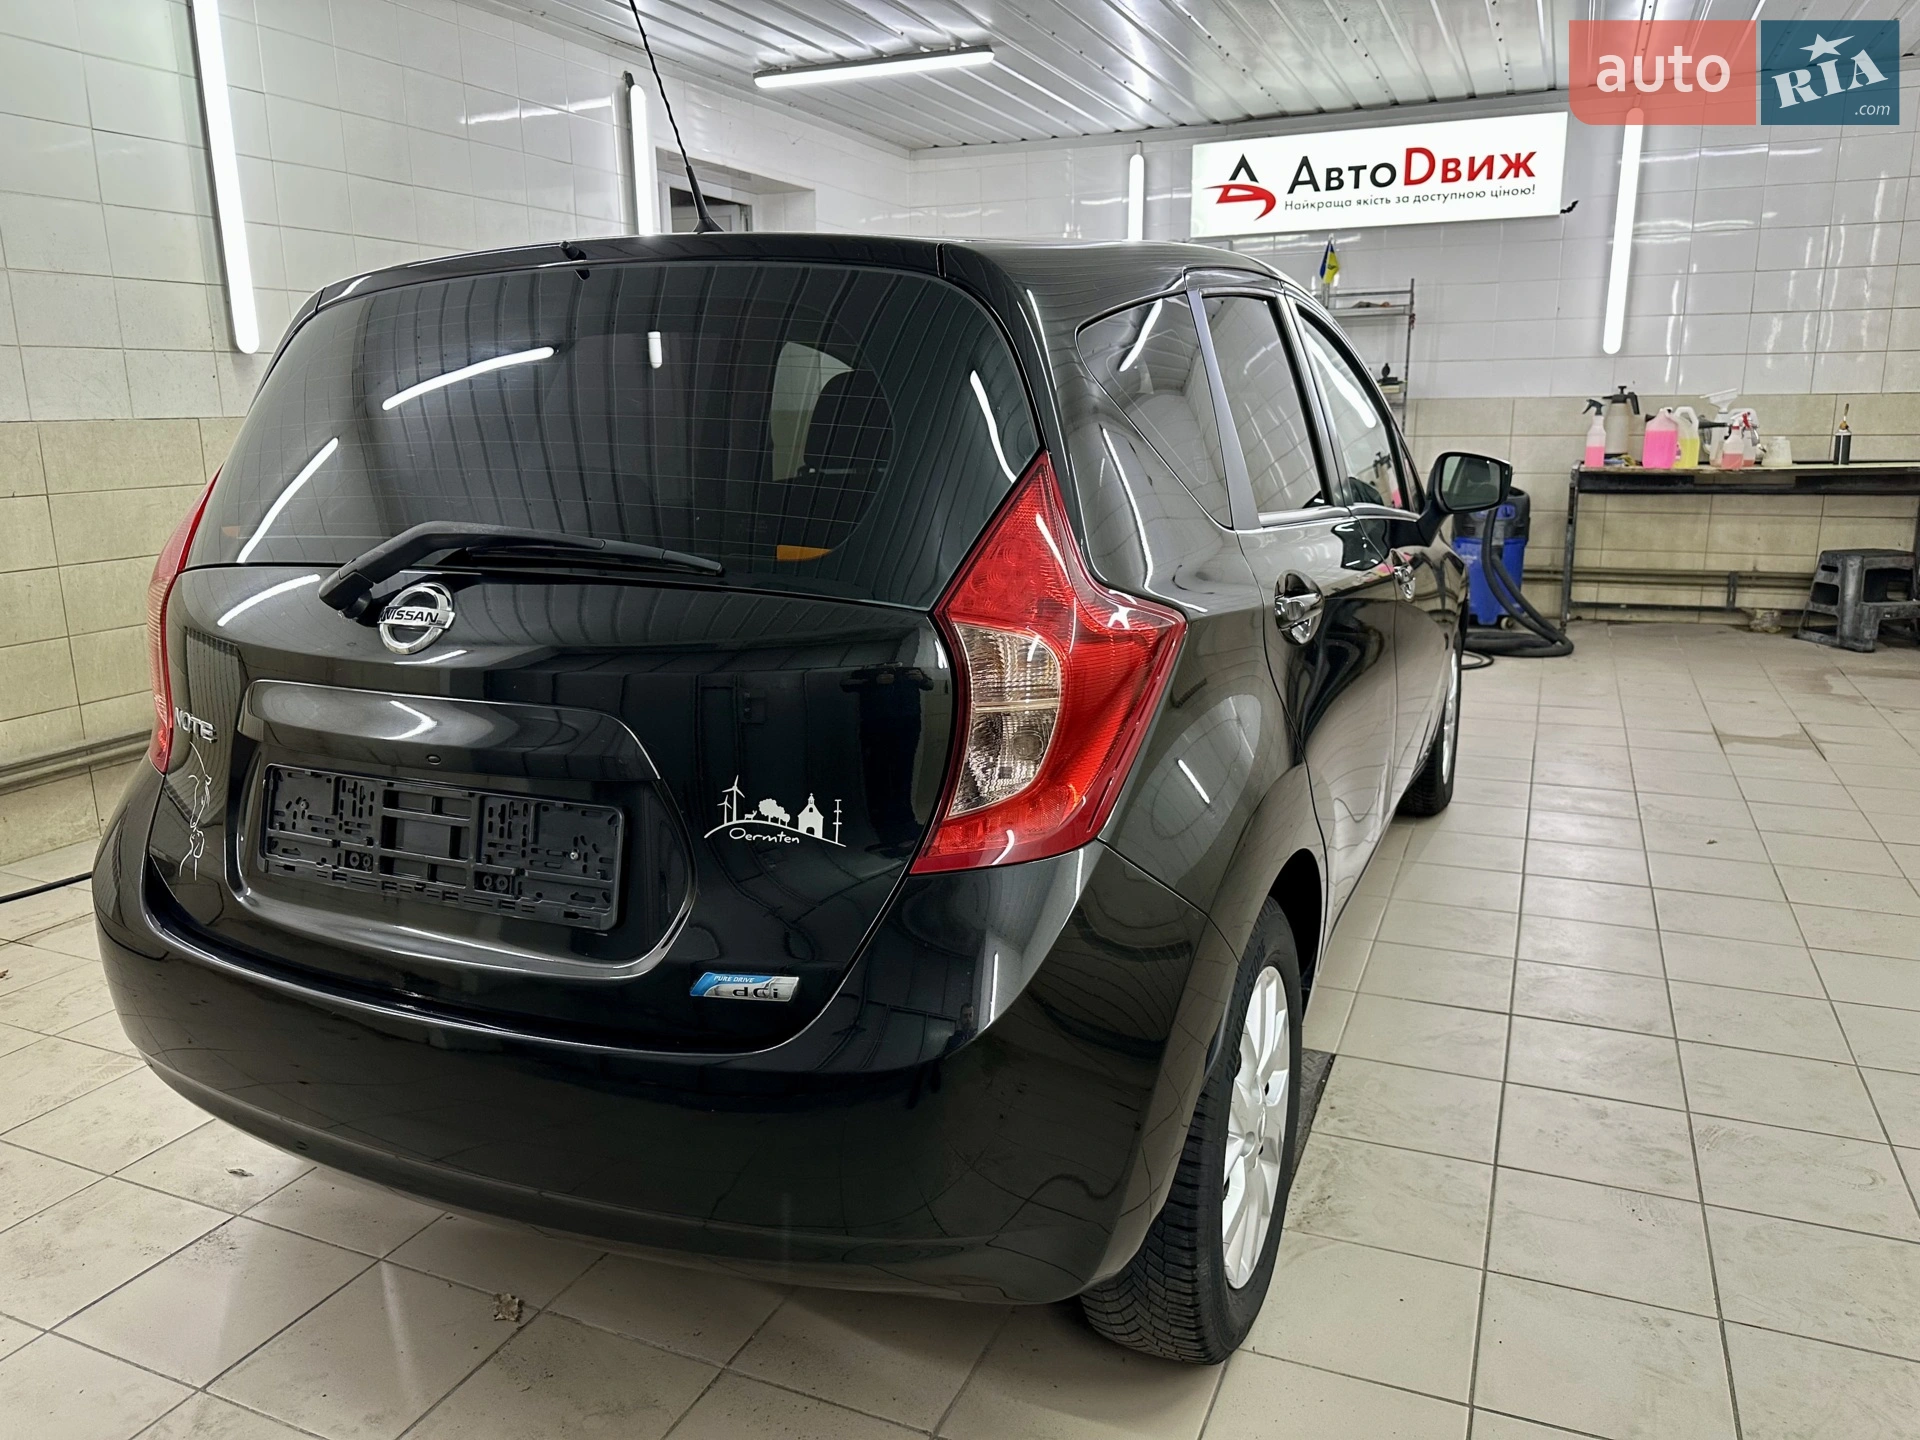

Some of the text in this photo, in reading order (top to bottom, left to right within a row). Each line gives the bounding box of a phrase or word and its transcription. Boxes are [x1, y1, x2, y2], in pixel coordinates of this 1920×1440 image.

[1284, 184, 1536, 212] Найкраща якість за доступною ціною!
[380, 608, 440, 623] NISSAN
[174, 706, 218, 744] NOTE
[729, 827, 800, 844] Oermten
